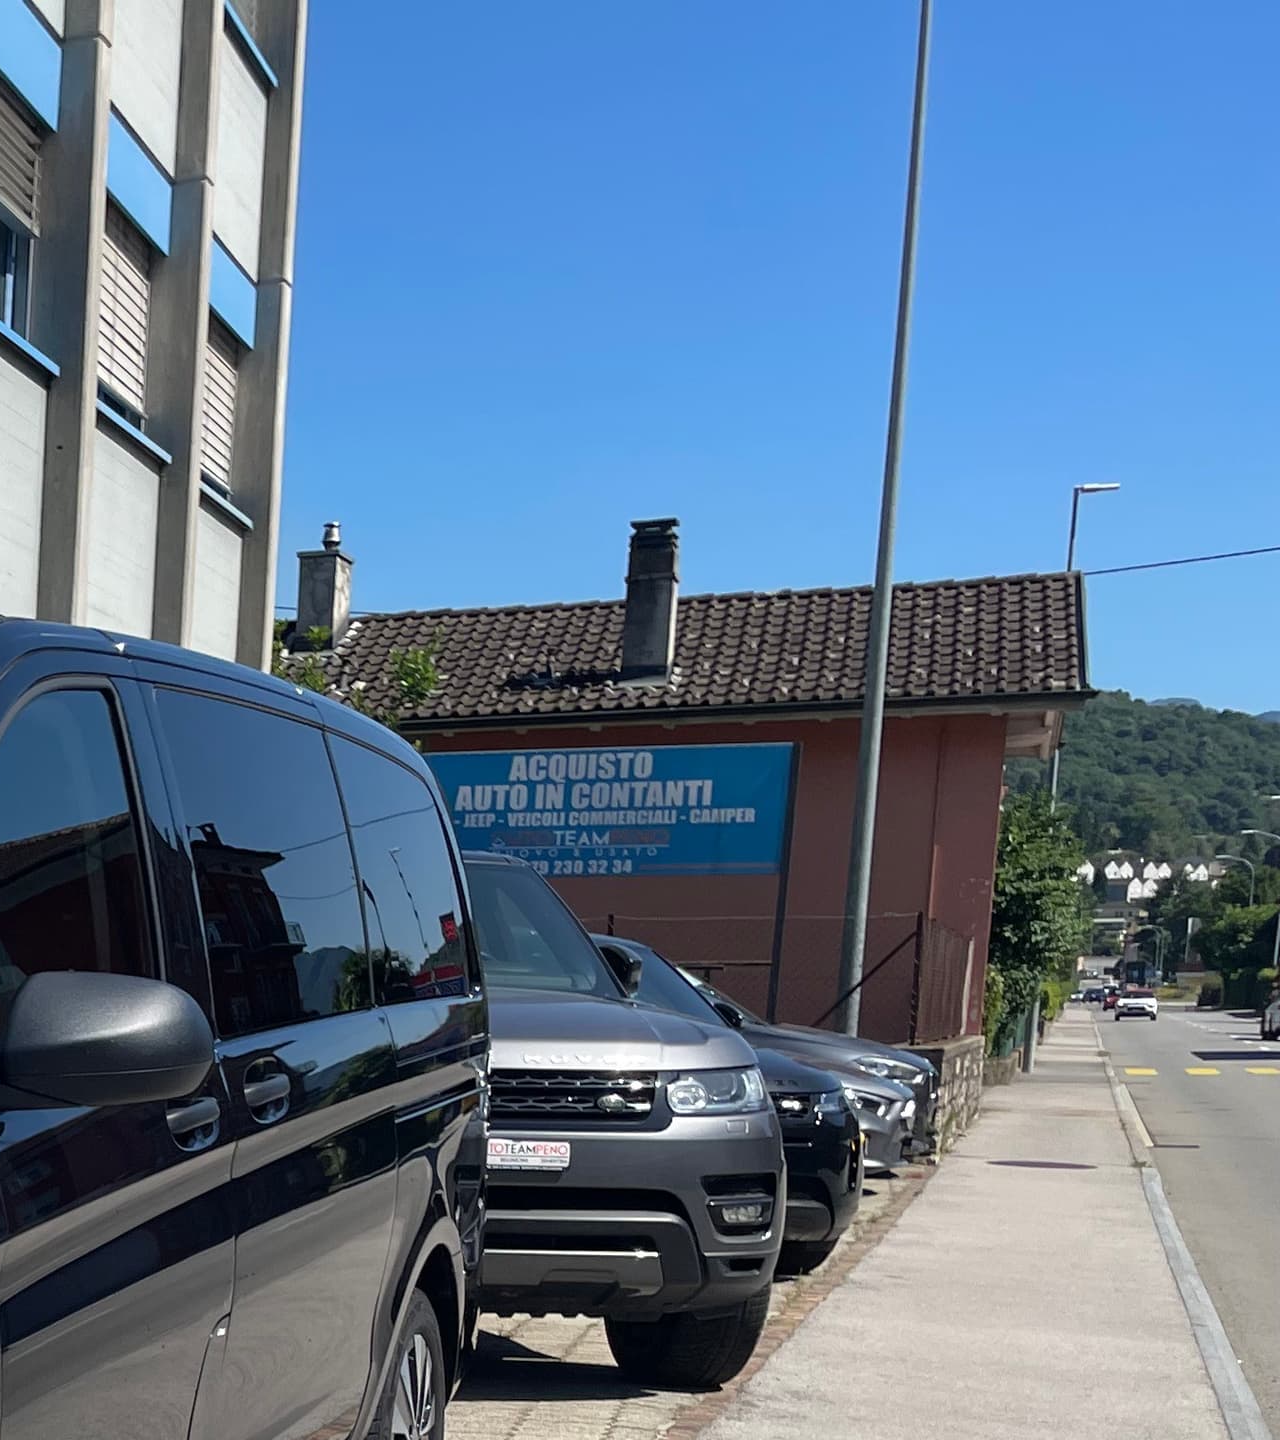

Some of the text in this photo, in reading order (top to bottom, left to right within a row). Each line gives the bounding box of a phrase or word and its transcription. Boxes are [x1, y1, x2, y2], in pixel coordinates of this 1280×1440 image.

[509, 752, 654, 784] ACQUISTO
[455, 779, 713, 811] AUTO IN CONTANTI
[508, 812, 565, 827] VEICOLI
[569, 810, 677, 826] COMMERCIALI
[690, 808, 755, 824] CAMPER
[553, 859, 583, 875] 230
[589, 859, 607, 874] 32
[613, 858, 633, 873] 34
